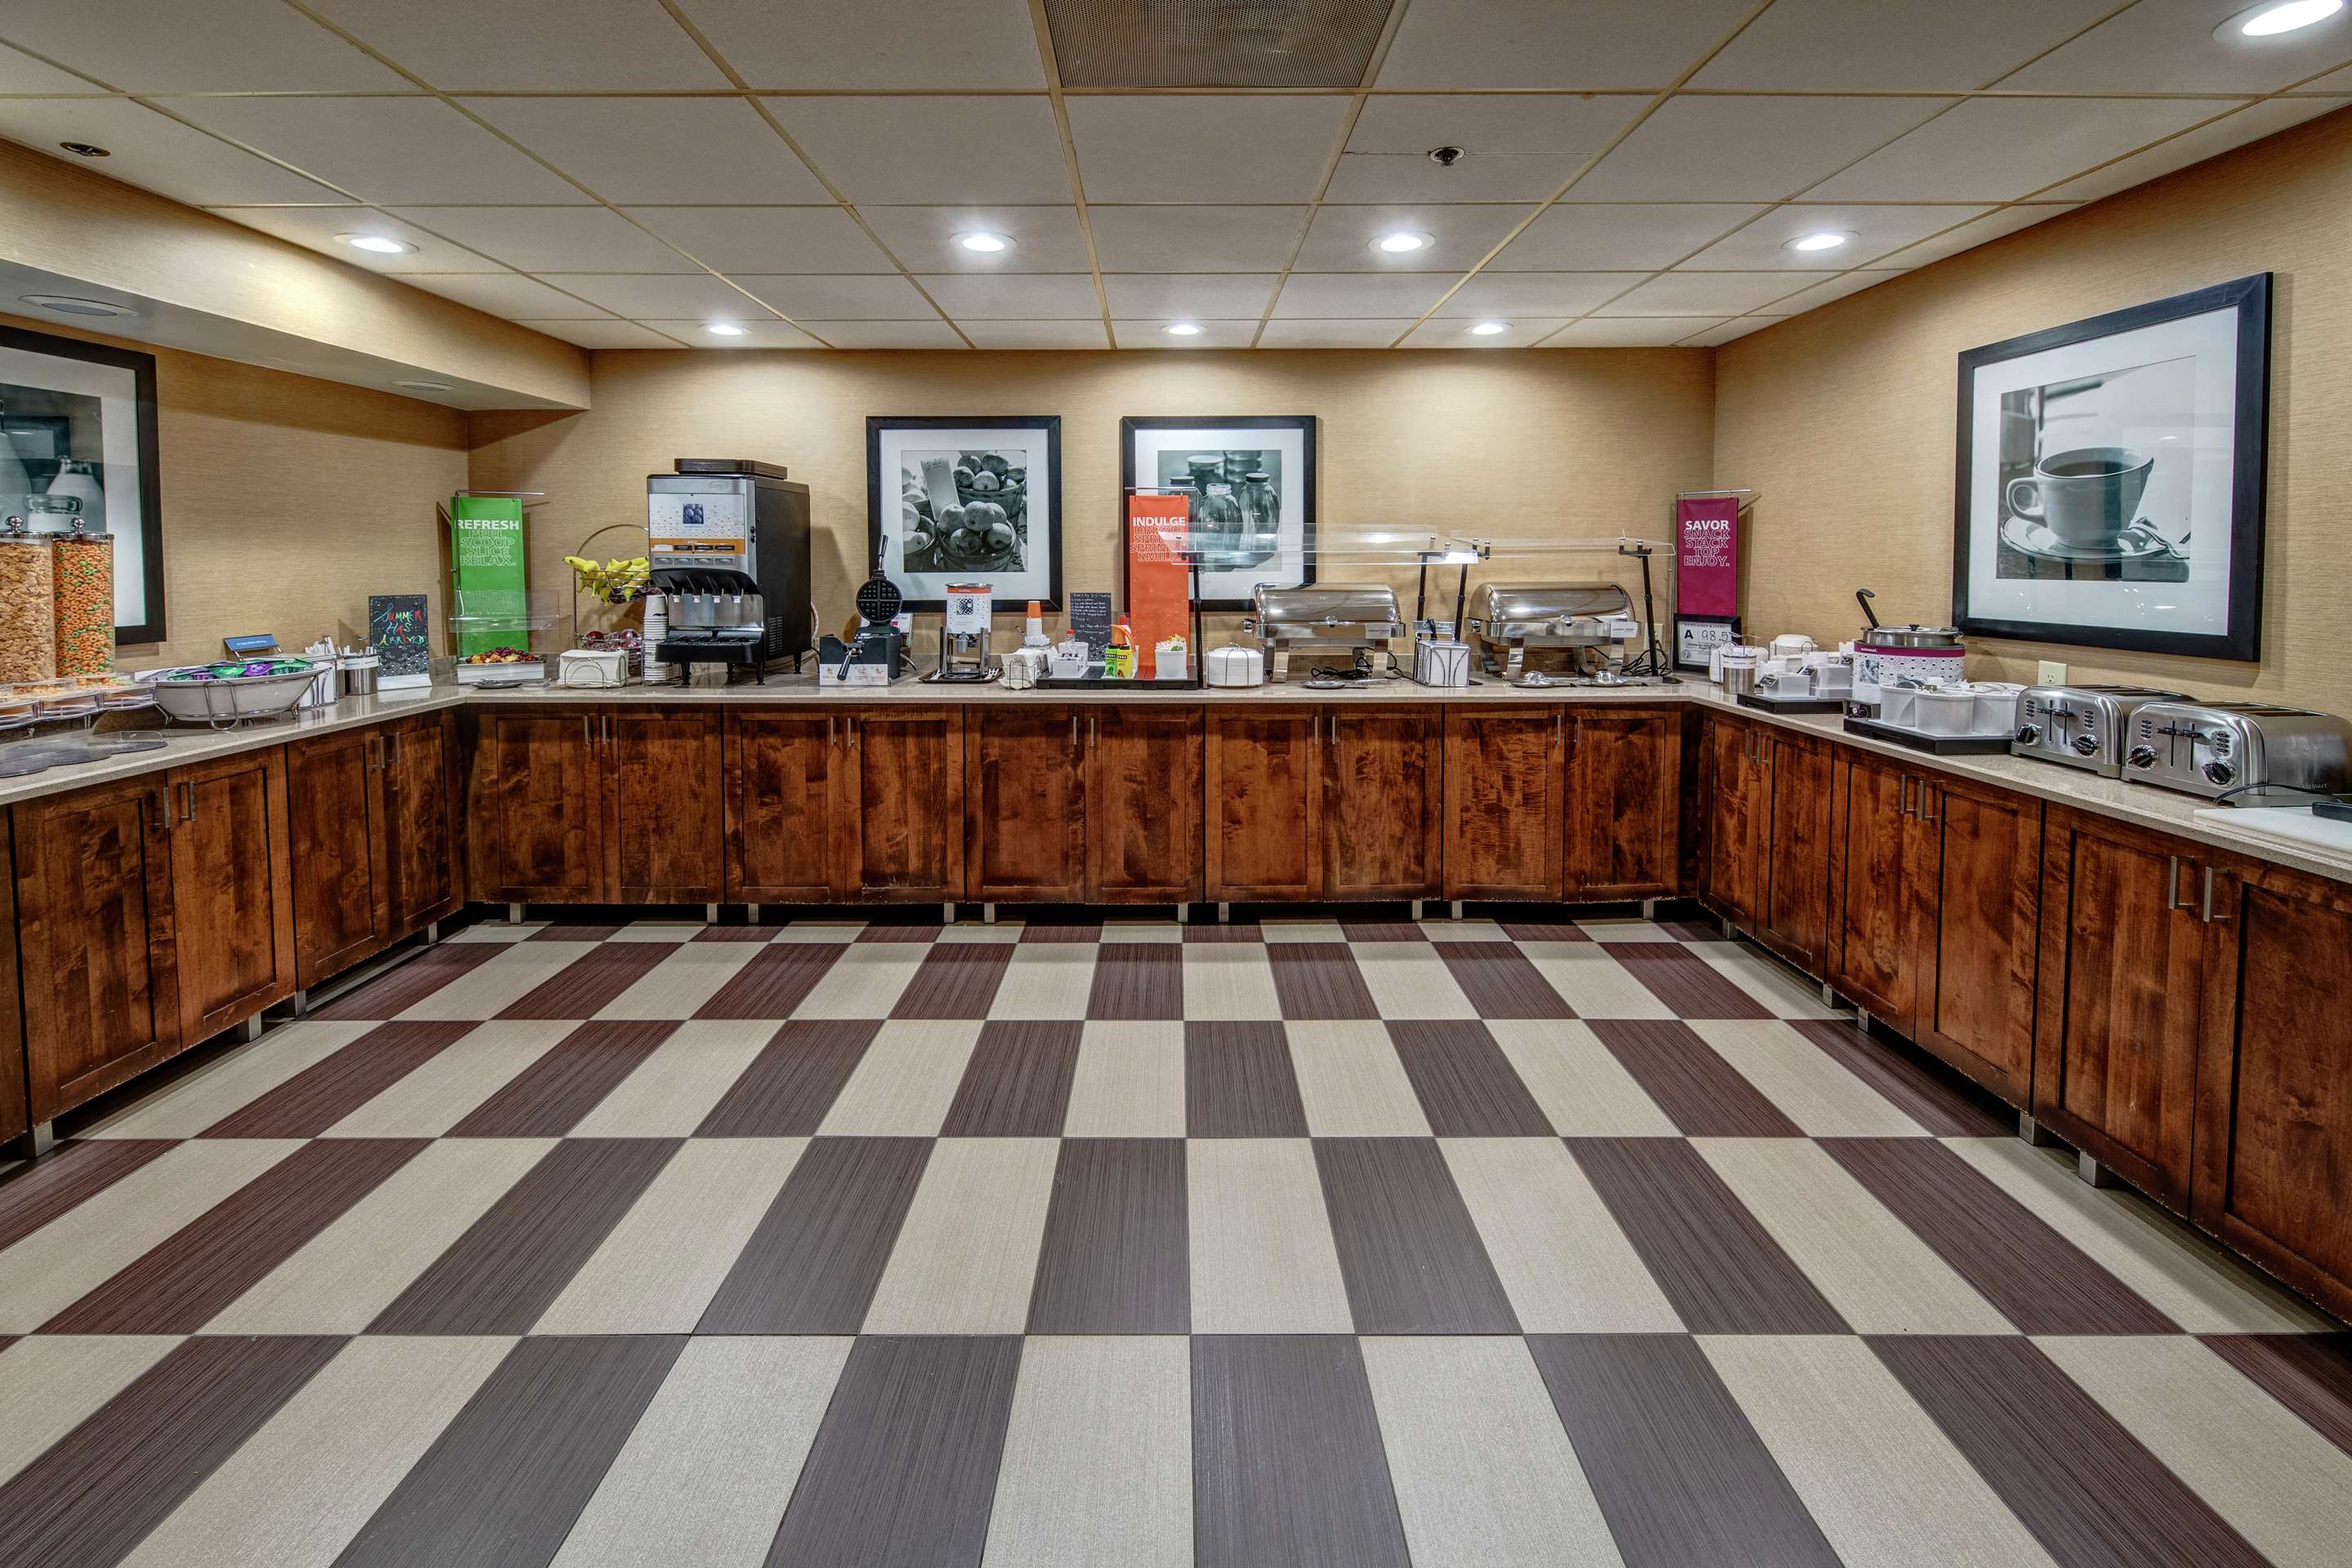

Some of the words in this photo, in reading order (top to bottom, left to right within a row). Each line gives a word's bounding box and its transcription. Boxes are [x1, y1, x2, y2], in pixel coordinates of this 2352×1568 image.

[454, 519, 519, 530] REFRESH
[1133, 516, 1186, 527] INDULGE
[1685, 520, 1730, 530] SAVOR
[469, 528, 506, 537] PEEL
[1683, 528, 1731, 539] SNACK
[461, 537, 515, 548] SCOOP
[1685, 537, 1729, 548] STACK
[466, 546, 510, 556] SLICE
[1693, 546, 1720, 557] TOP
[460, 555, 517, 567] RELAX.
[1683, 555, 1731, 567] ENJOY.
[373, 603, 423, 623] SUMMER
[385, 621, 412, 635] HAS
[377, 634, 425, 647] ARRIVED
[1684, 630, 1694, 639] A
[1701, 630, 1729, 641] 98.5
